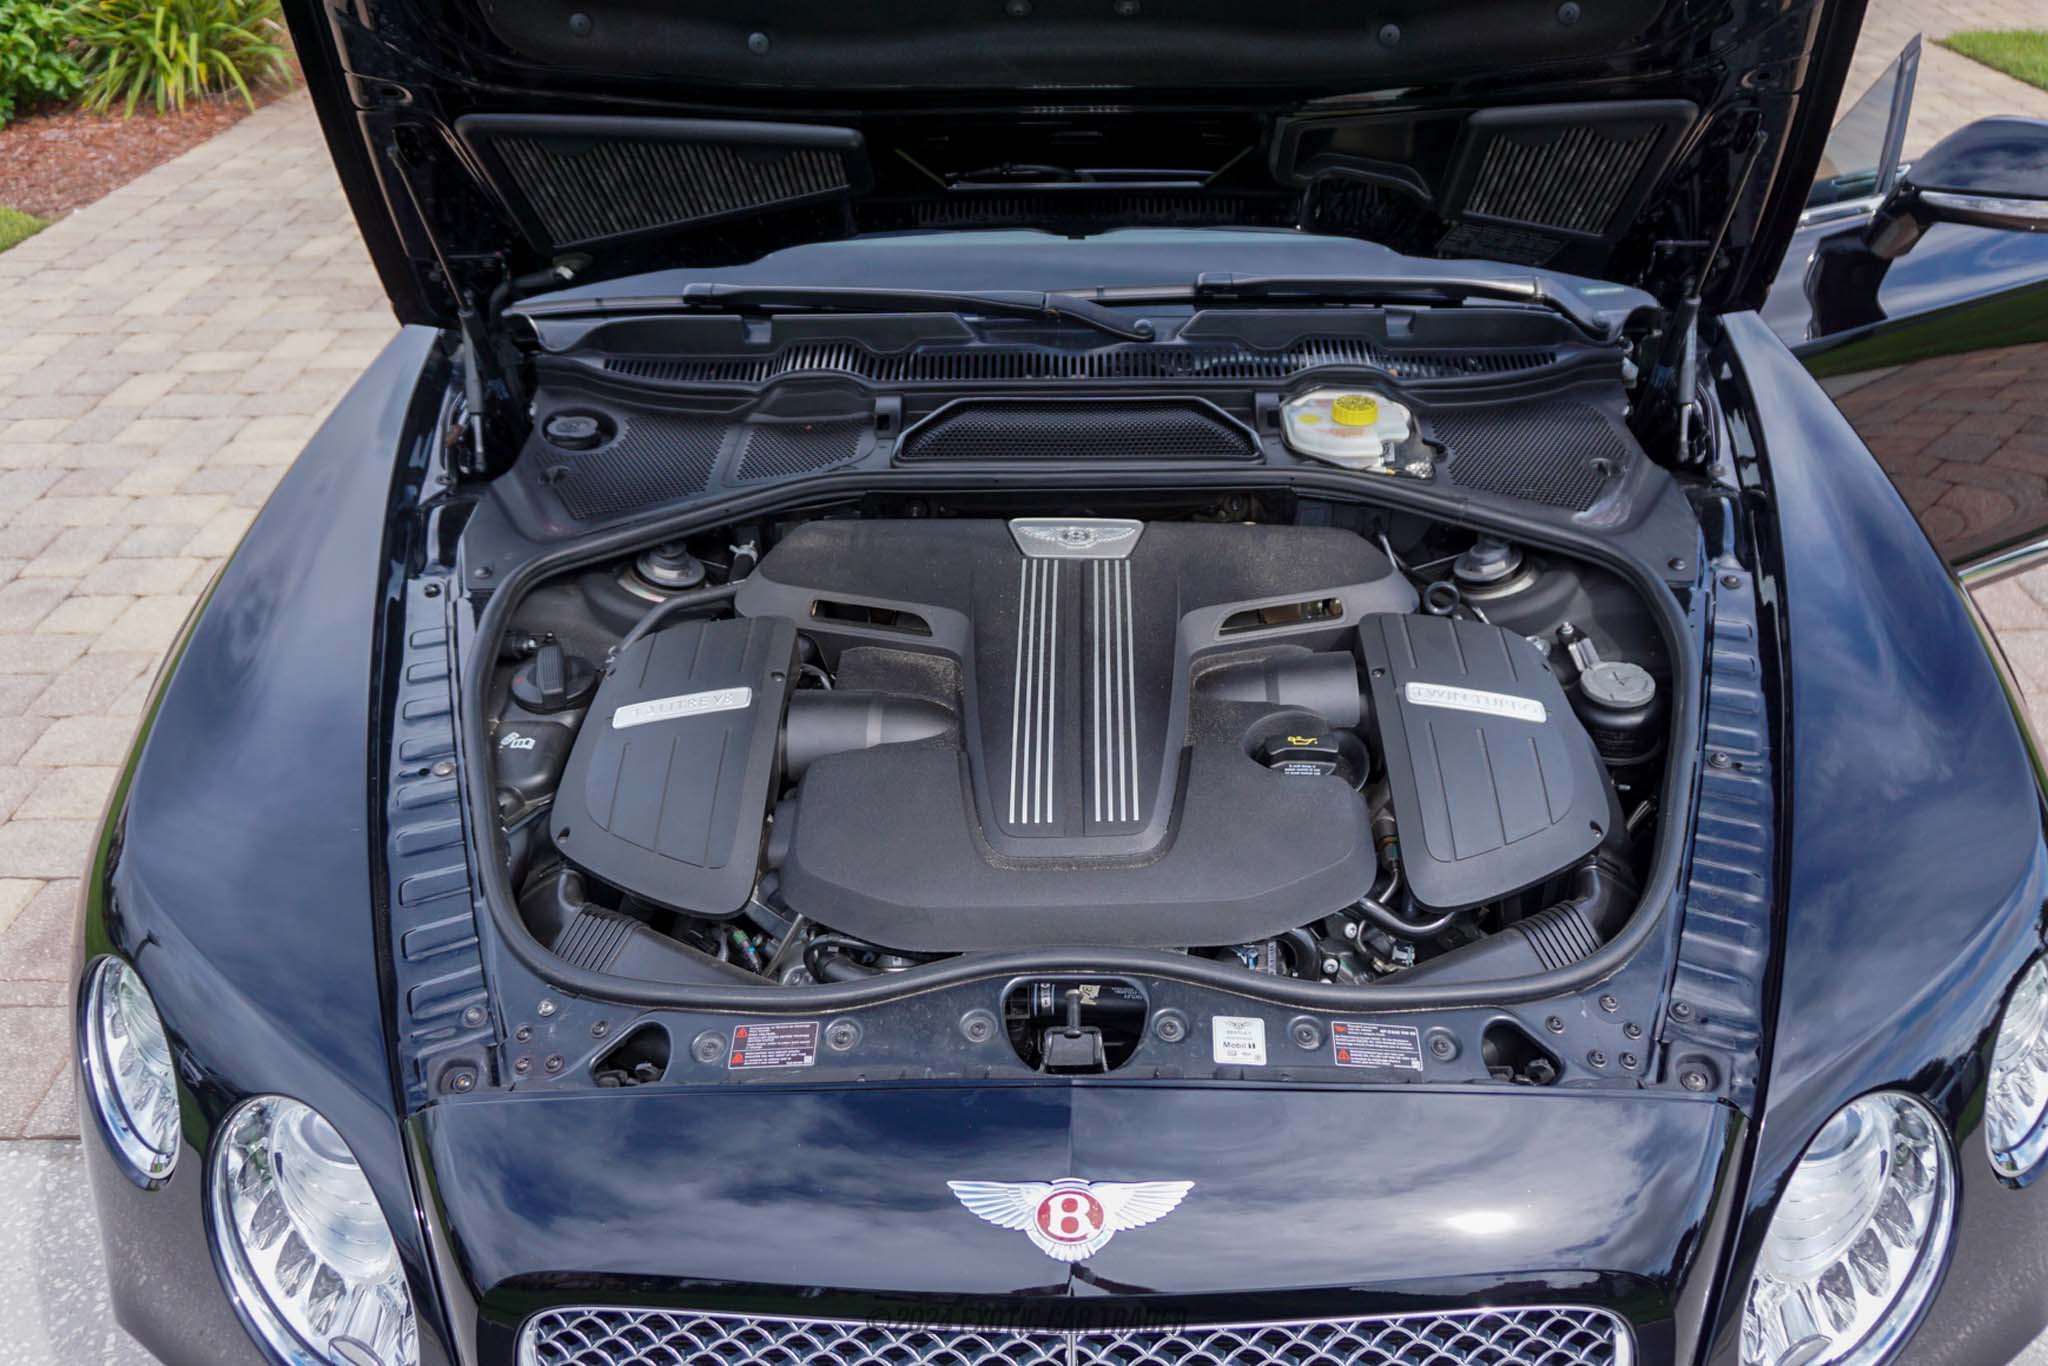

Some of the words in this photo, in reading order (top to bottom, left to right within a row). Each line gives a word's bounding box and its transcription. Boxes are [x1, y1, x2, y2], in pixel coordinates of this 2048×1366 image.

[659, 696, 710, 714] LITRE
[712, 691, 735, 706] V8
[1412, 686, 1468, 704] TWIN
[1223, 1041, 1247, 1049] Mobil
